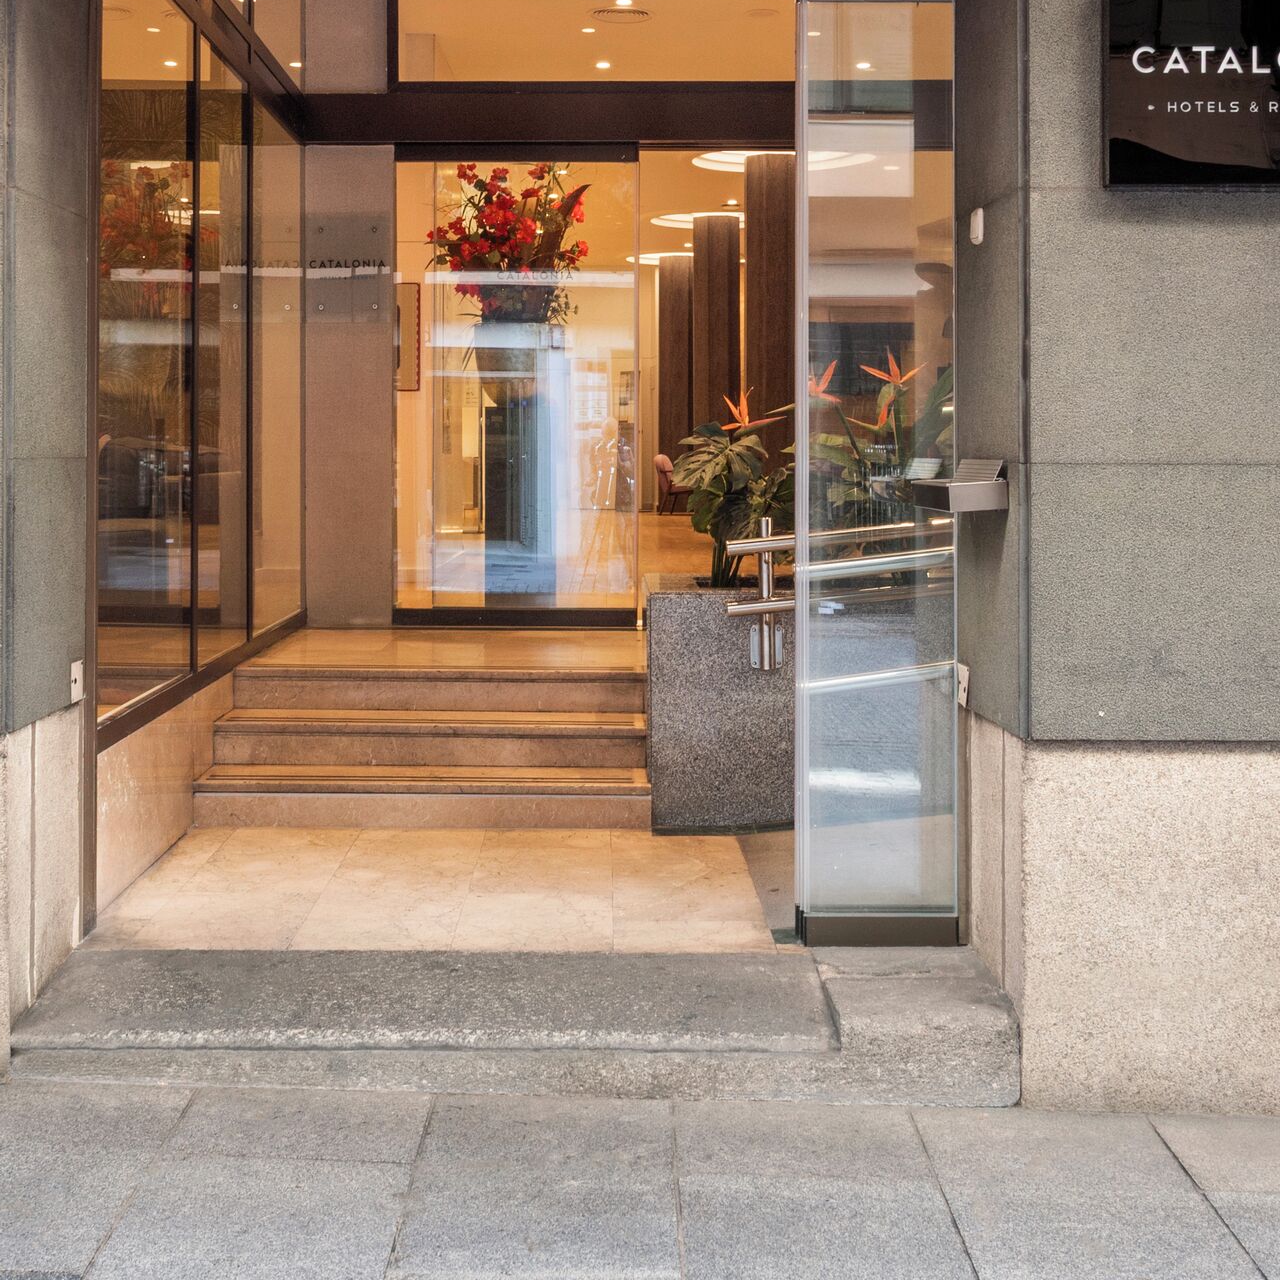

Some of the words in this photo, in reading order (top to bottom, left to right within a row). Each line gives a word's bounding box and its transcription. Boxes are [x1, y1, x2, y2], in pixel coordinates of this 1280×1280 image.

[1167, 101, 1240, 113] HOTELS
[1249, 101, 1259, 113] &
[309, 258, 386, 269] CATALONIA
[496, 271, 574, 281] CATALONIA
